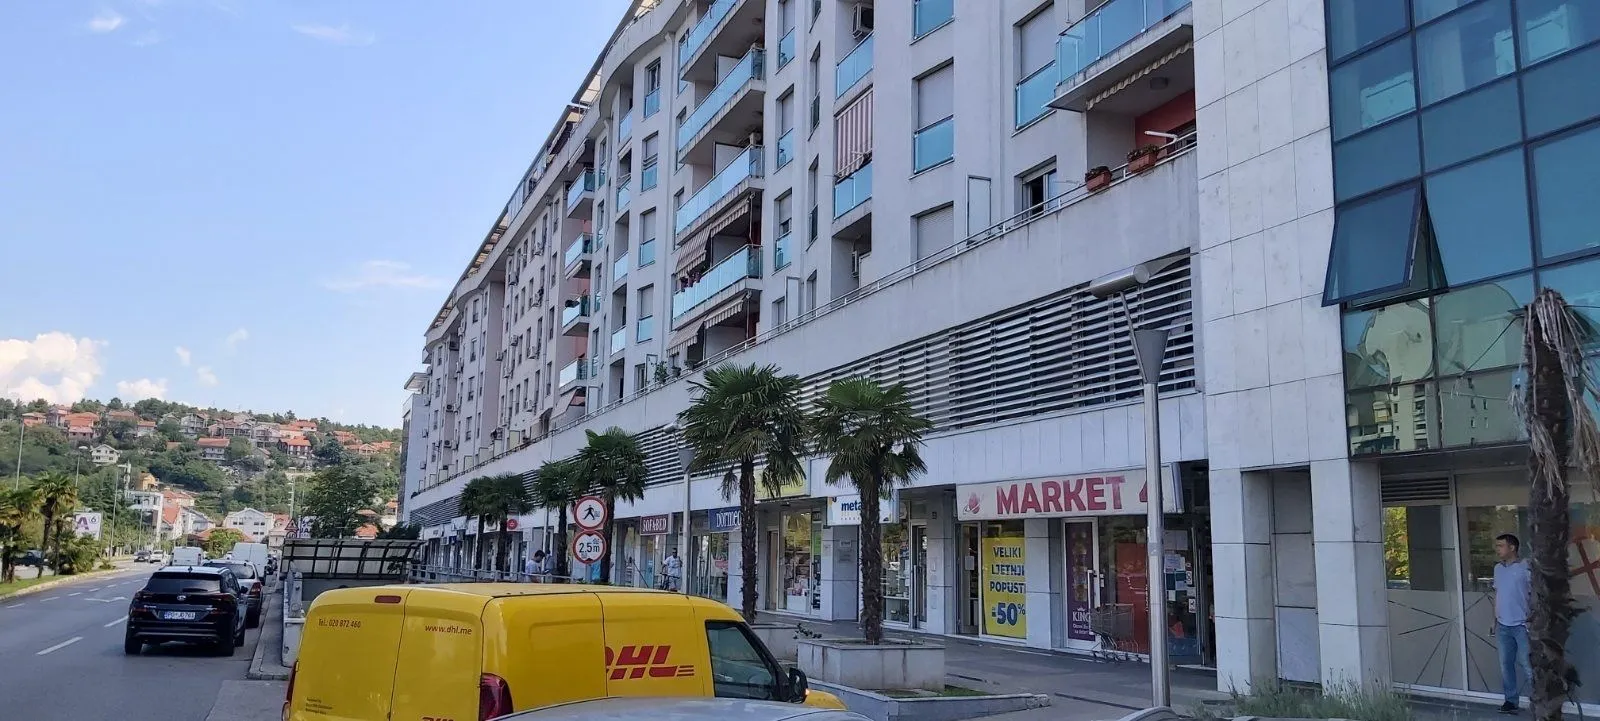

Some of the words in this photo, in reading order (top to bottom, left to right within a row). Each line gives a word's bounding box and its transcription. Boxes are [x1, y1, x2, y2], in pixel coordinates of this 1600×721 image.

[996, 475, 1126, 515] MARKET
[993, 547, 1022, 558] VELIKI
[992, 564, 1025, 576] LJETNJI
[425, 625, 472, 635] www.dhl.me
